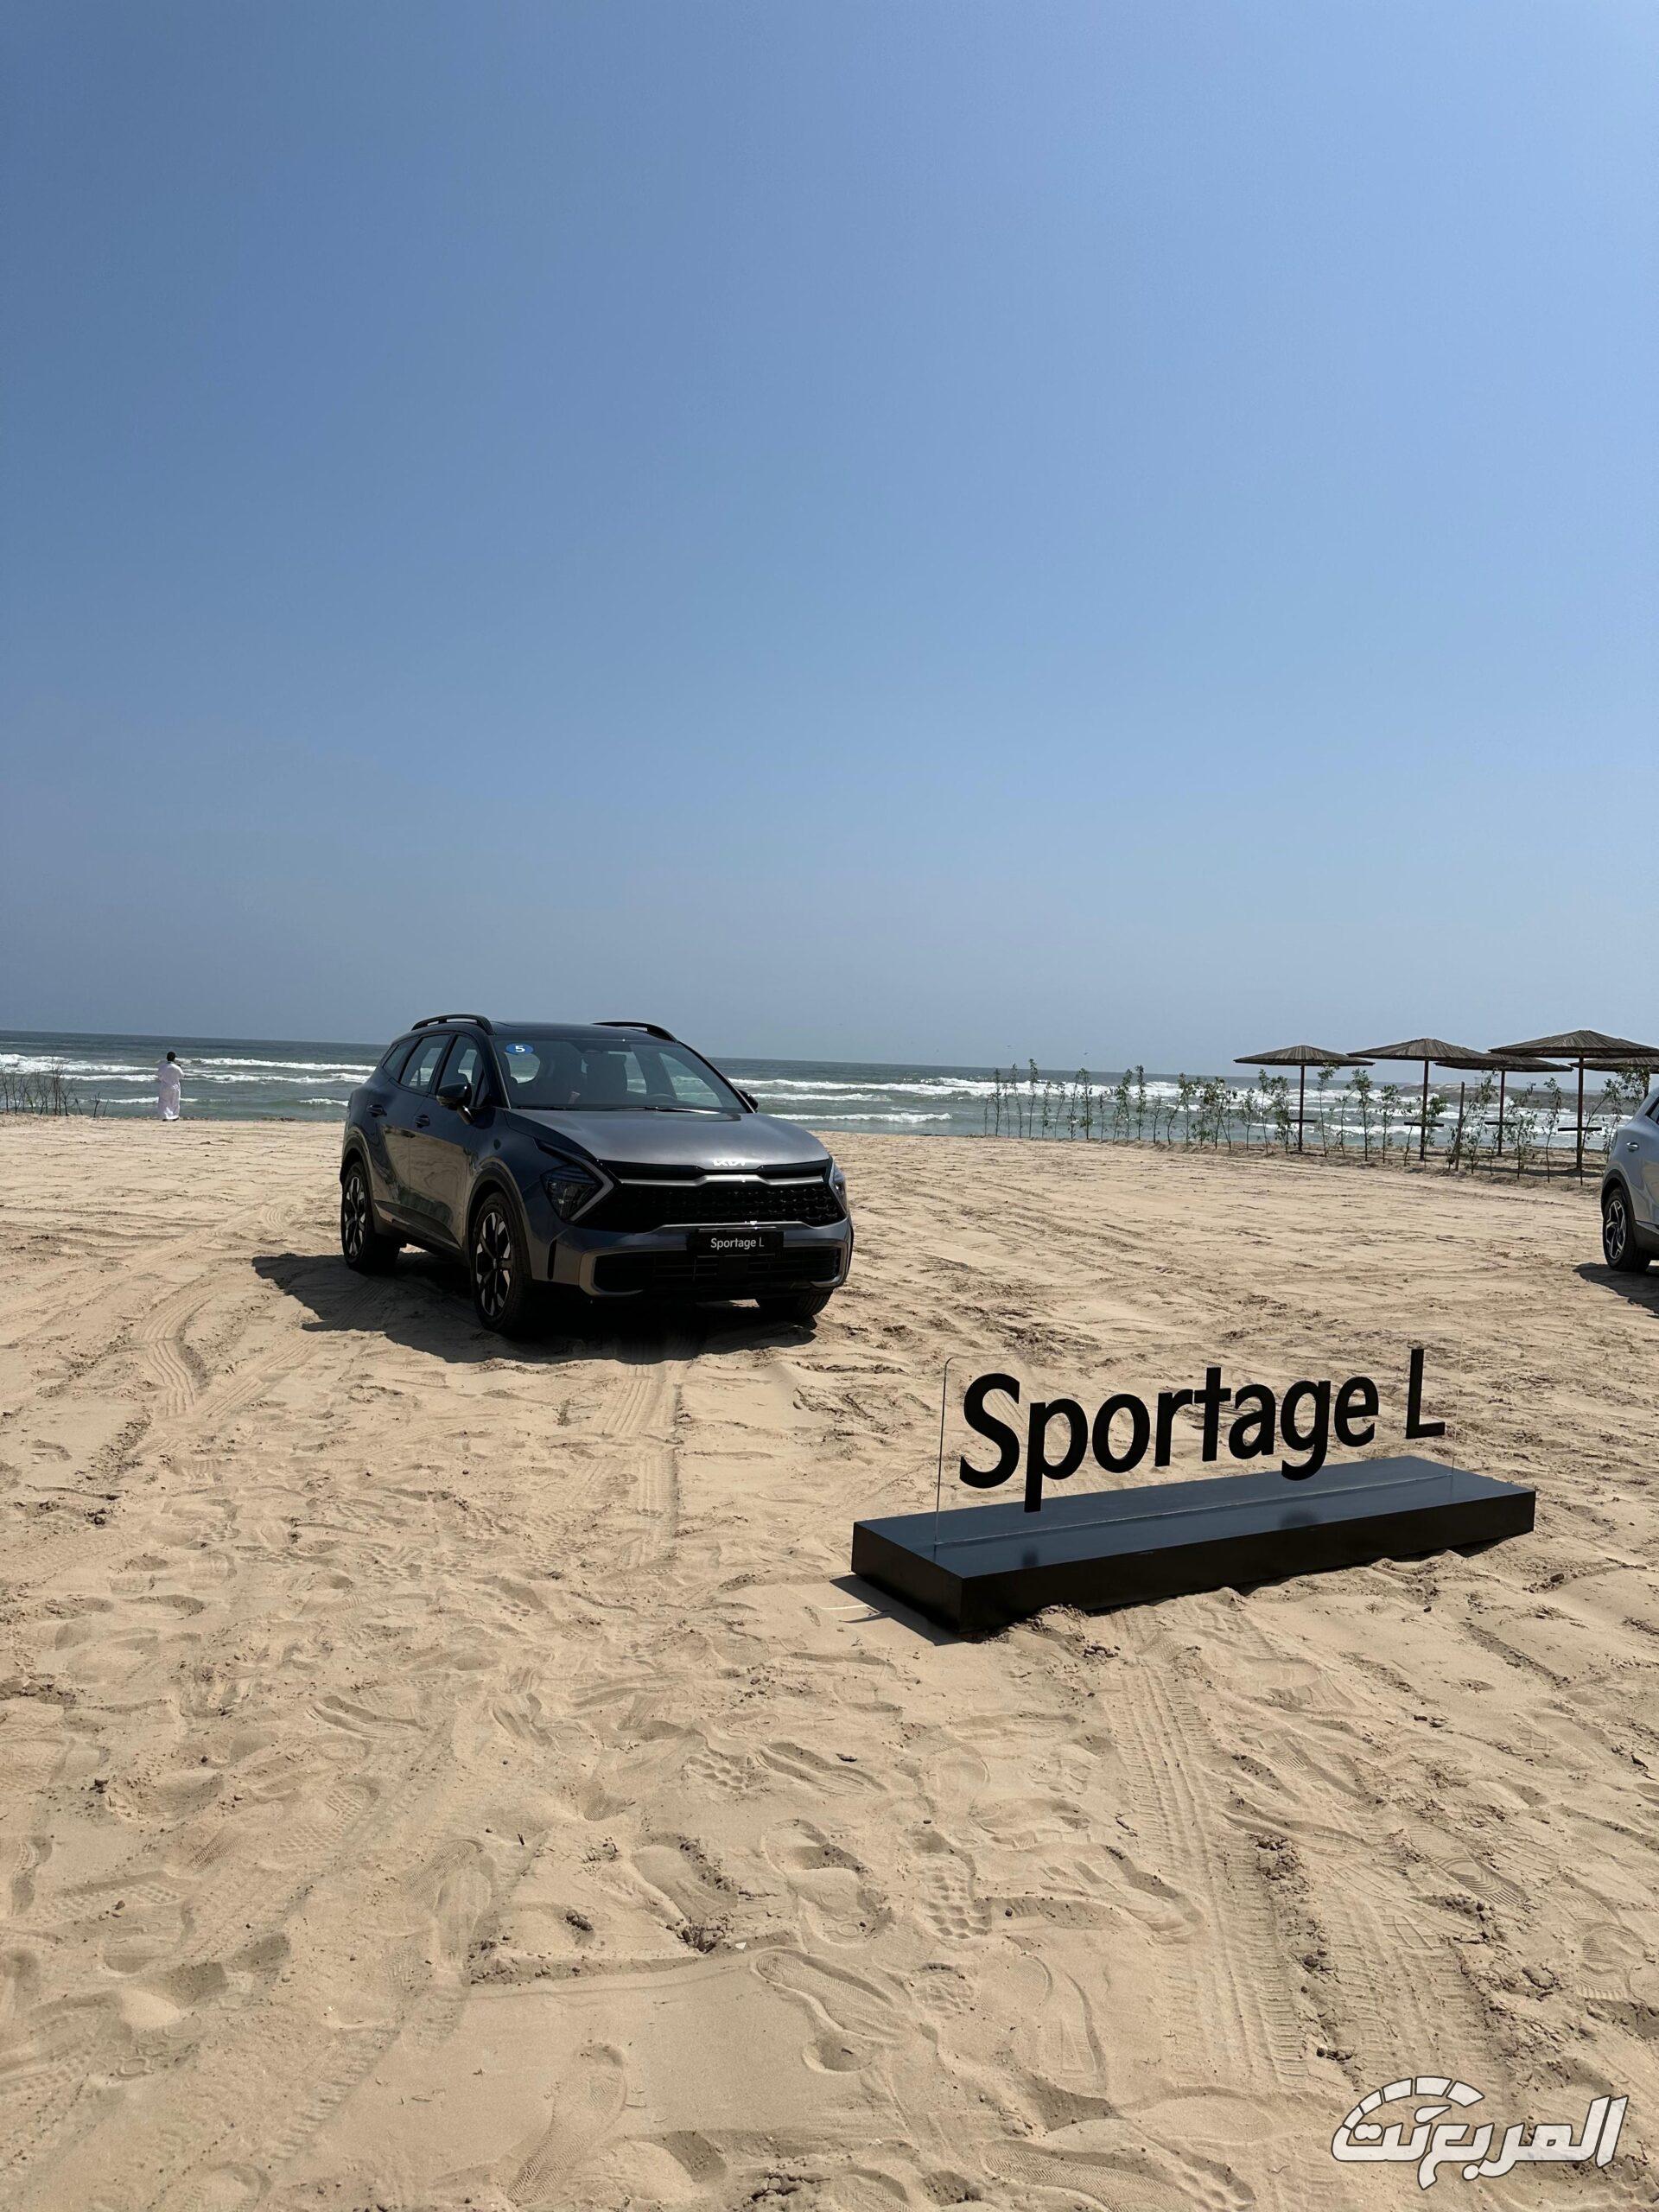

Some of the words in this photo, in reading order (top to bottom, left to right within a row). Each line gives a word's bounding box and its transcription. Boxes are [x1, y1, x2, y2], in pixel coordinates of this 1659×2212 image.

[710, 1237, 756, 1250] Sportage
[759, 1236, 764, 1247] L
[959, 1366, 1379, 1514] Sportage
[1403, 1347, 1446, 1440] L
